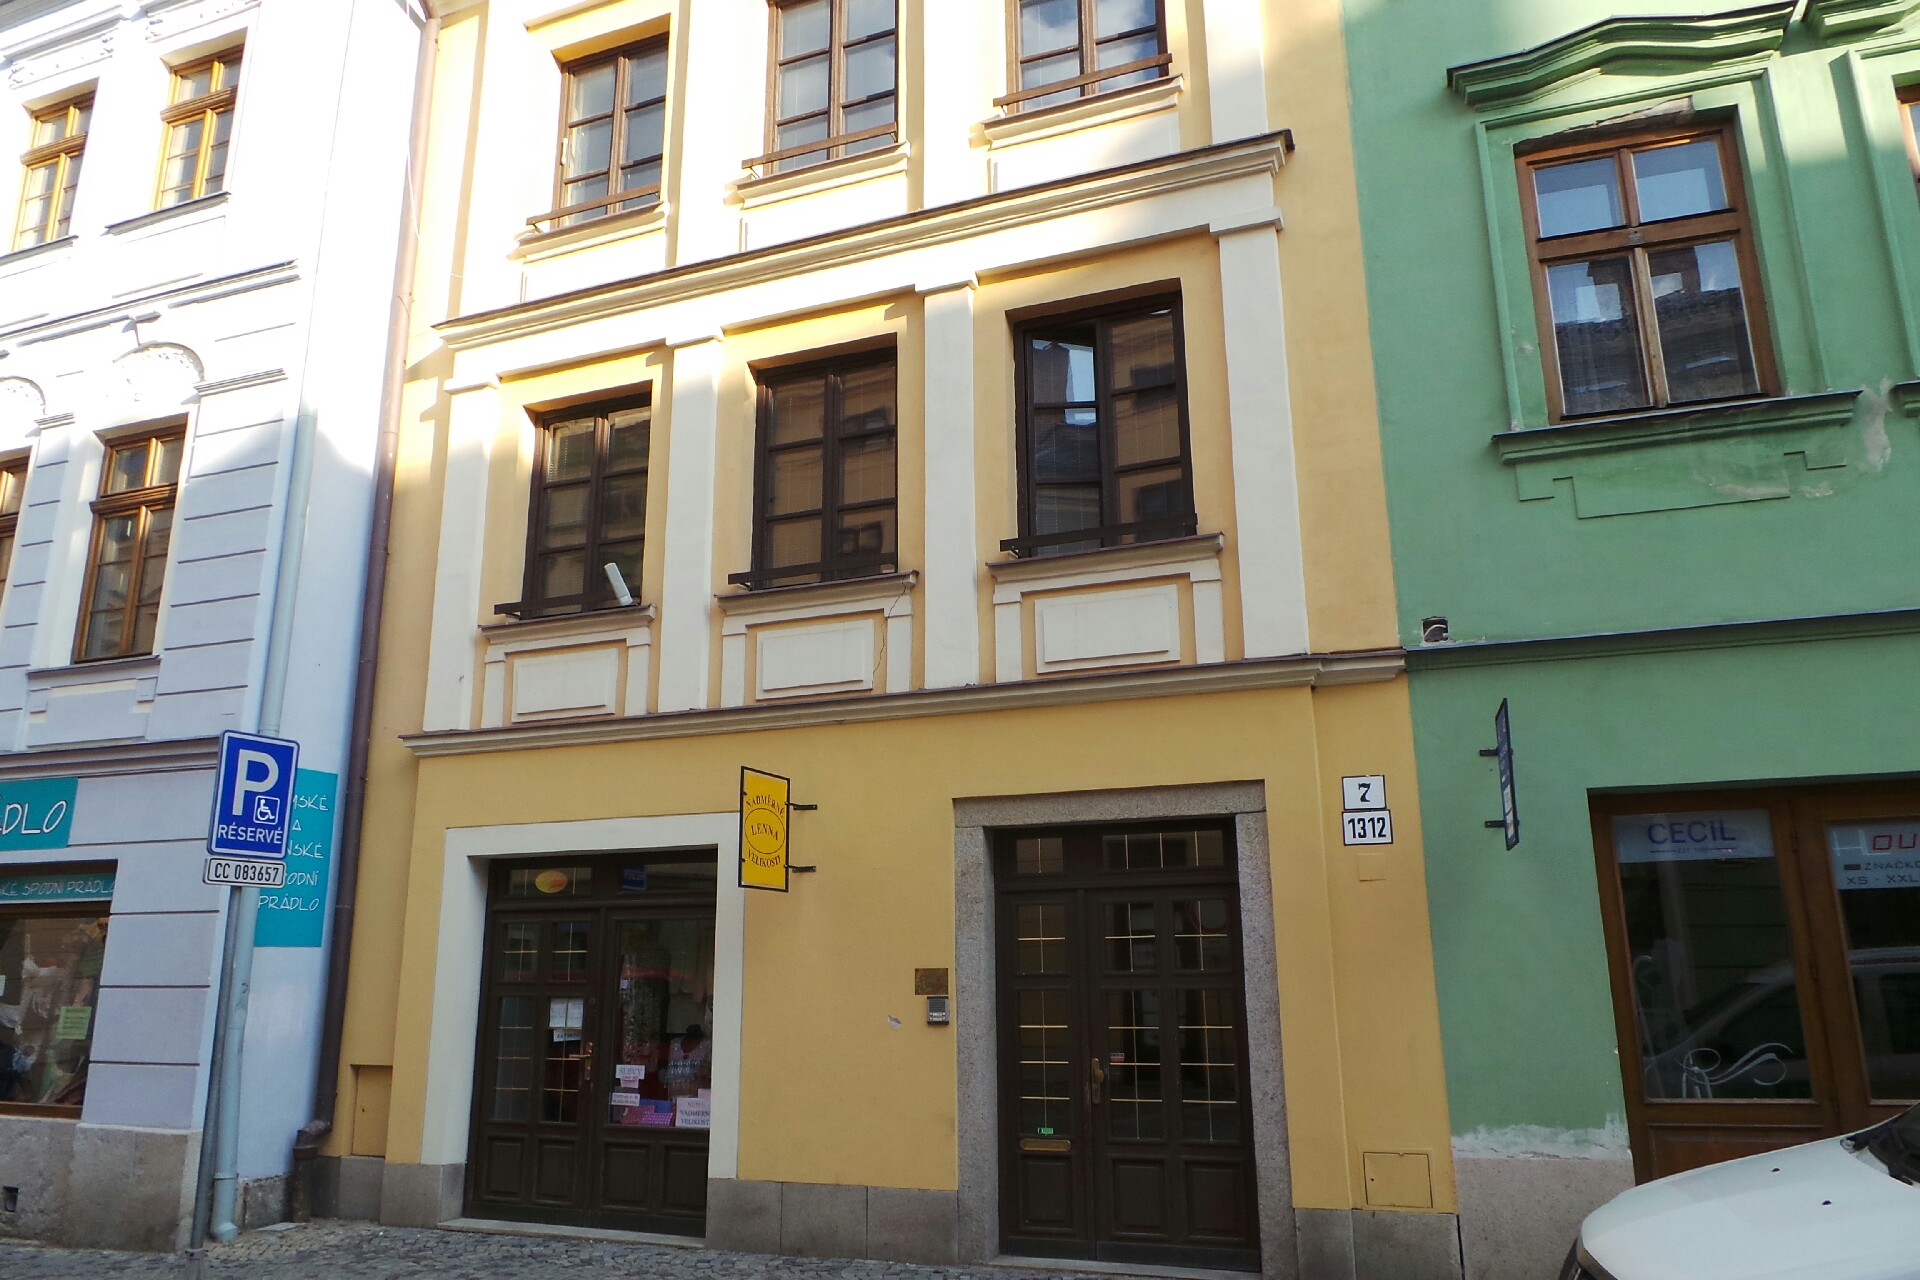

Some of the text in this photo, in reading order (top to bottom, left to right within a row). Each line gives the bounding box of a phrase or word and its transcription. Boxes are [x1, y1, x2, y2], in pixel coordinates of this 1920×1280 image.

[232, 748, 279, 816] P
[1358, 783, 1371, 803] 7
[0, 794, 67, 835] DLO
[746, 794, 785, 818] NADMĚRNÉ
[217, 822, 284, 845] RÉSERVÉ
[291, 819, 302, 831] A
[751, 823, 779, 841] LENNA
[1348, 817, 1387, 838] 1312
[1647, 820, 1737, 845] CECIL
[748, 849, 781, 868] VELIKOSTI
[214, 863, 280, 883] CC 083657
[285, 870, 319, 886] ODNÍ
[1846, 876, 1868, 885] XS
[258, 895, 319, 911] PRÁDLO
